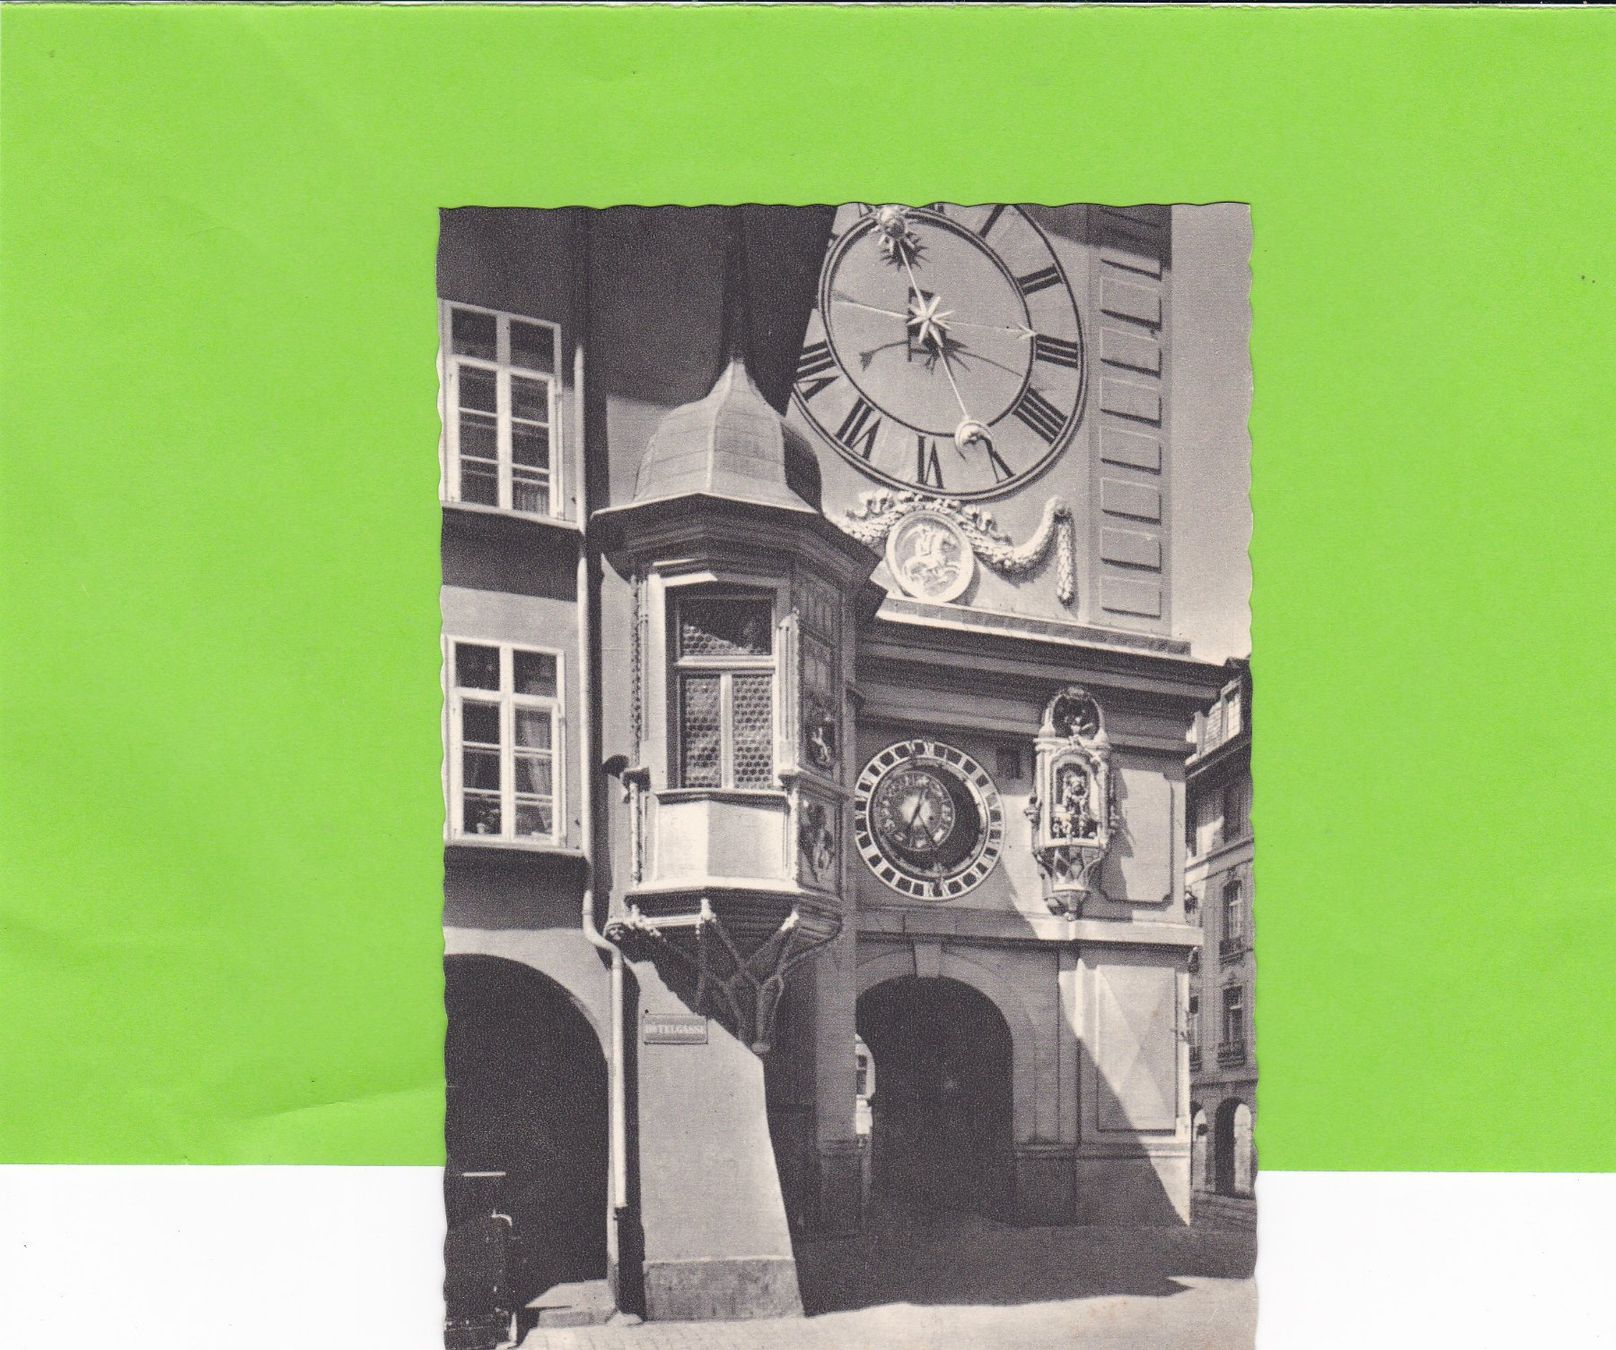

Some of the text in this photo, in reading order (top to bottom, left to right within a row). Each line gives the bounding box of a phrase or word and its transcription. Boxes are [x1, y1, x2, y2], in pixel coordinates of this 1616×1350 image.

[1014, 263, 1065, 296] II
[1035, 333, 1080, 369] III
[834, 395, 882, 463] VII
[1012, 384, 1069, 446] IIII
[915, 433, 946, 490] VI
